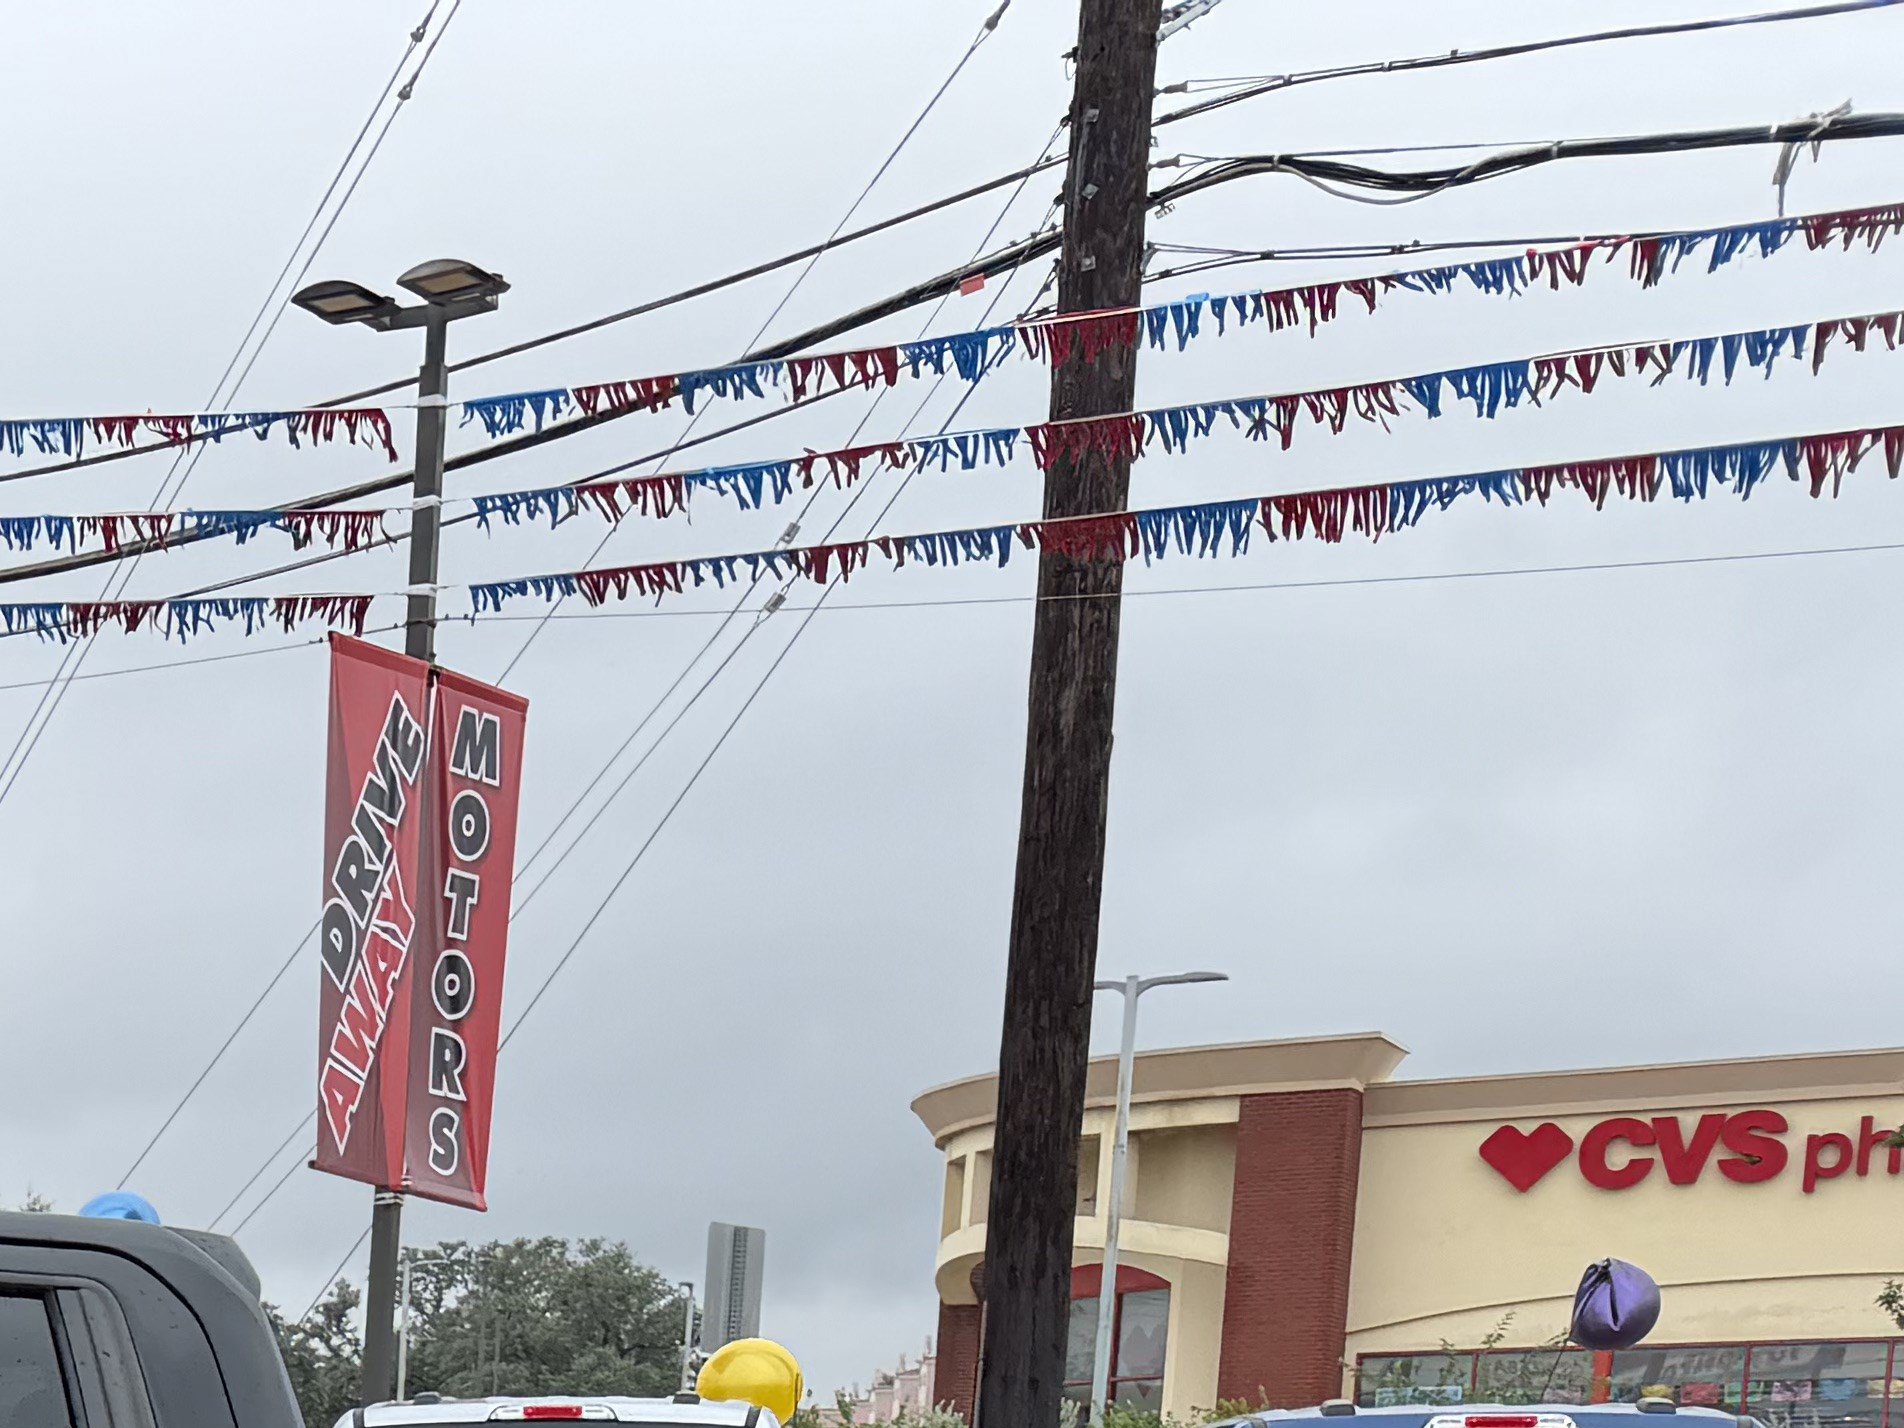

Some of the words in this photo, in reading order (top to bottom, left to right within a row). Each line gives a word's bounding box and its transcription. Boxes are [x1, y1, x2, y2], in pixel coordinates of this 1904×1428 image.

[321, 690, 424, 992] DRIVE
[429, 704, 499, 1177] MOTORS
[319, 858, 415, 1157] AWAY
[1579, 1109, 1789, 1191] CVS
